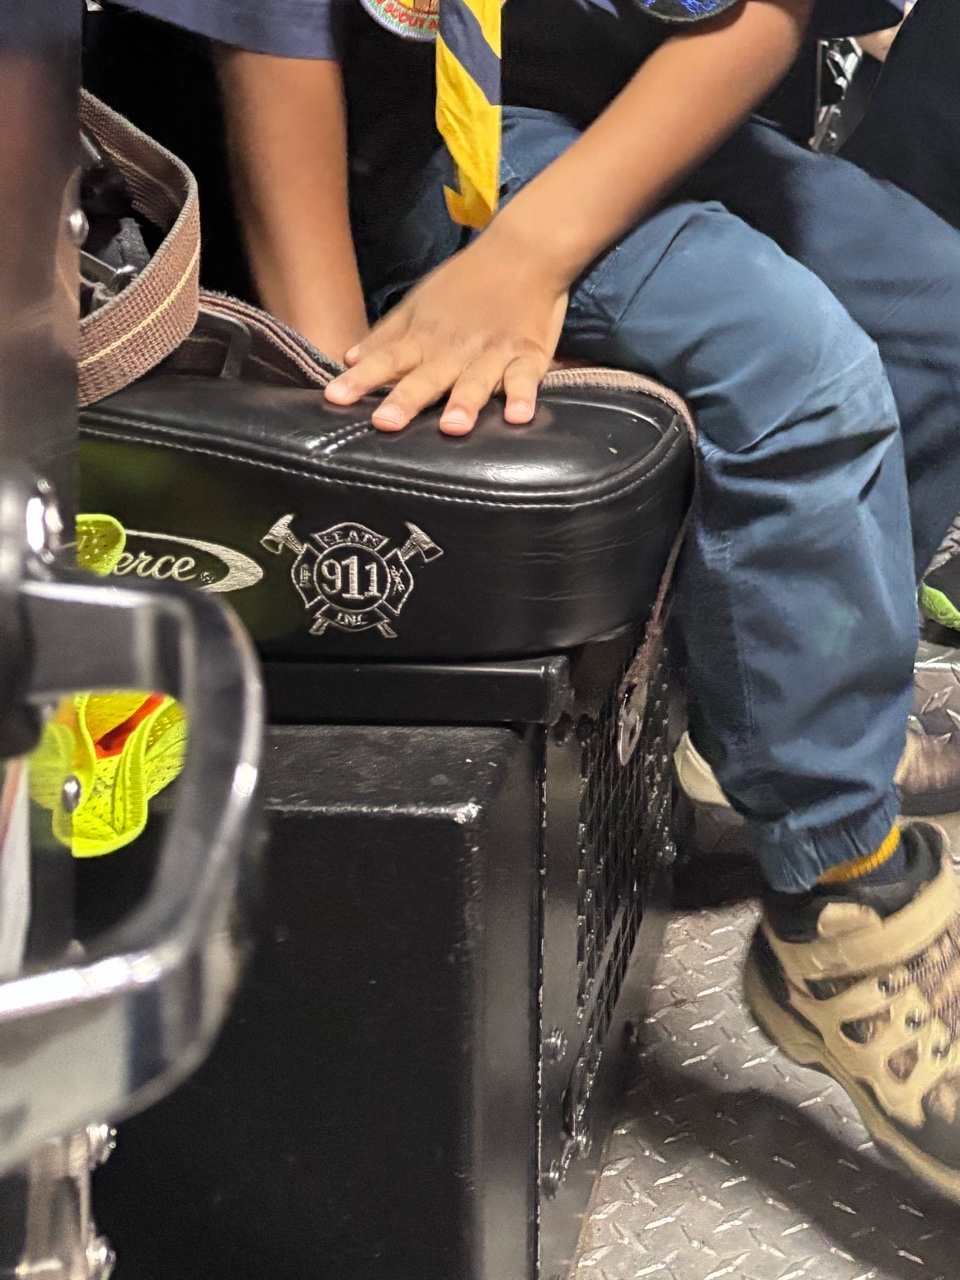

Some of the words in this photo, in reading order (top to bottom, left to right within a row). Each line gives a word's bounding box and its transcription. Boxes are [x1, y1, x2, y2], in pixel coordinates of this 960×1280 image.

[384, 3, 426, 30] SCOUT
[324, 530, 384, 547] SEATS
[114, 552, 197, 582] erce
[320, 555, 382, 600] 911
